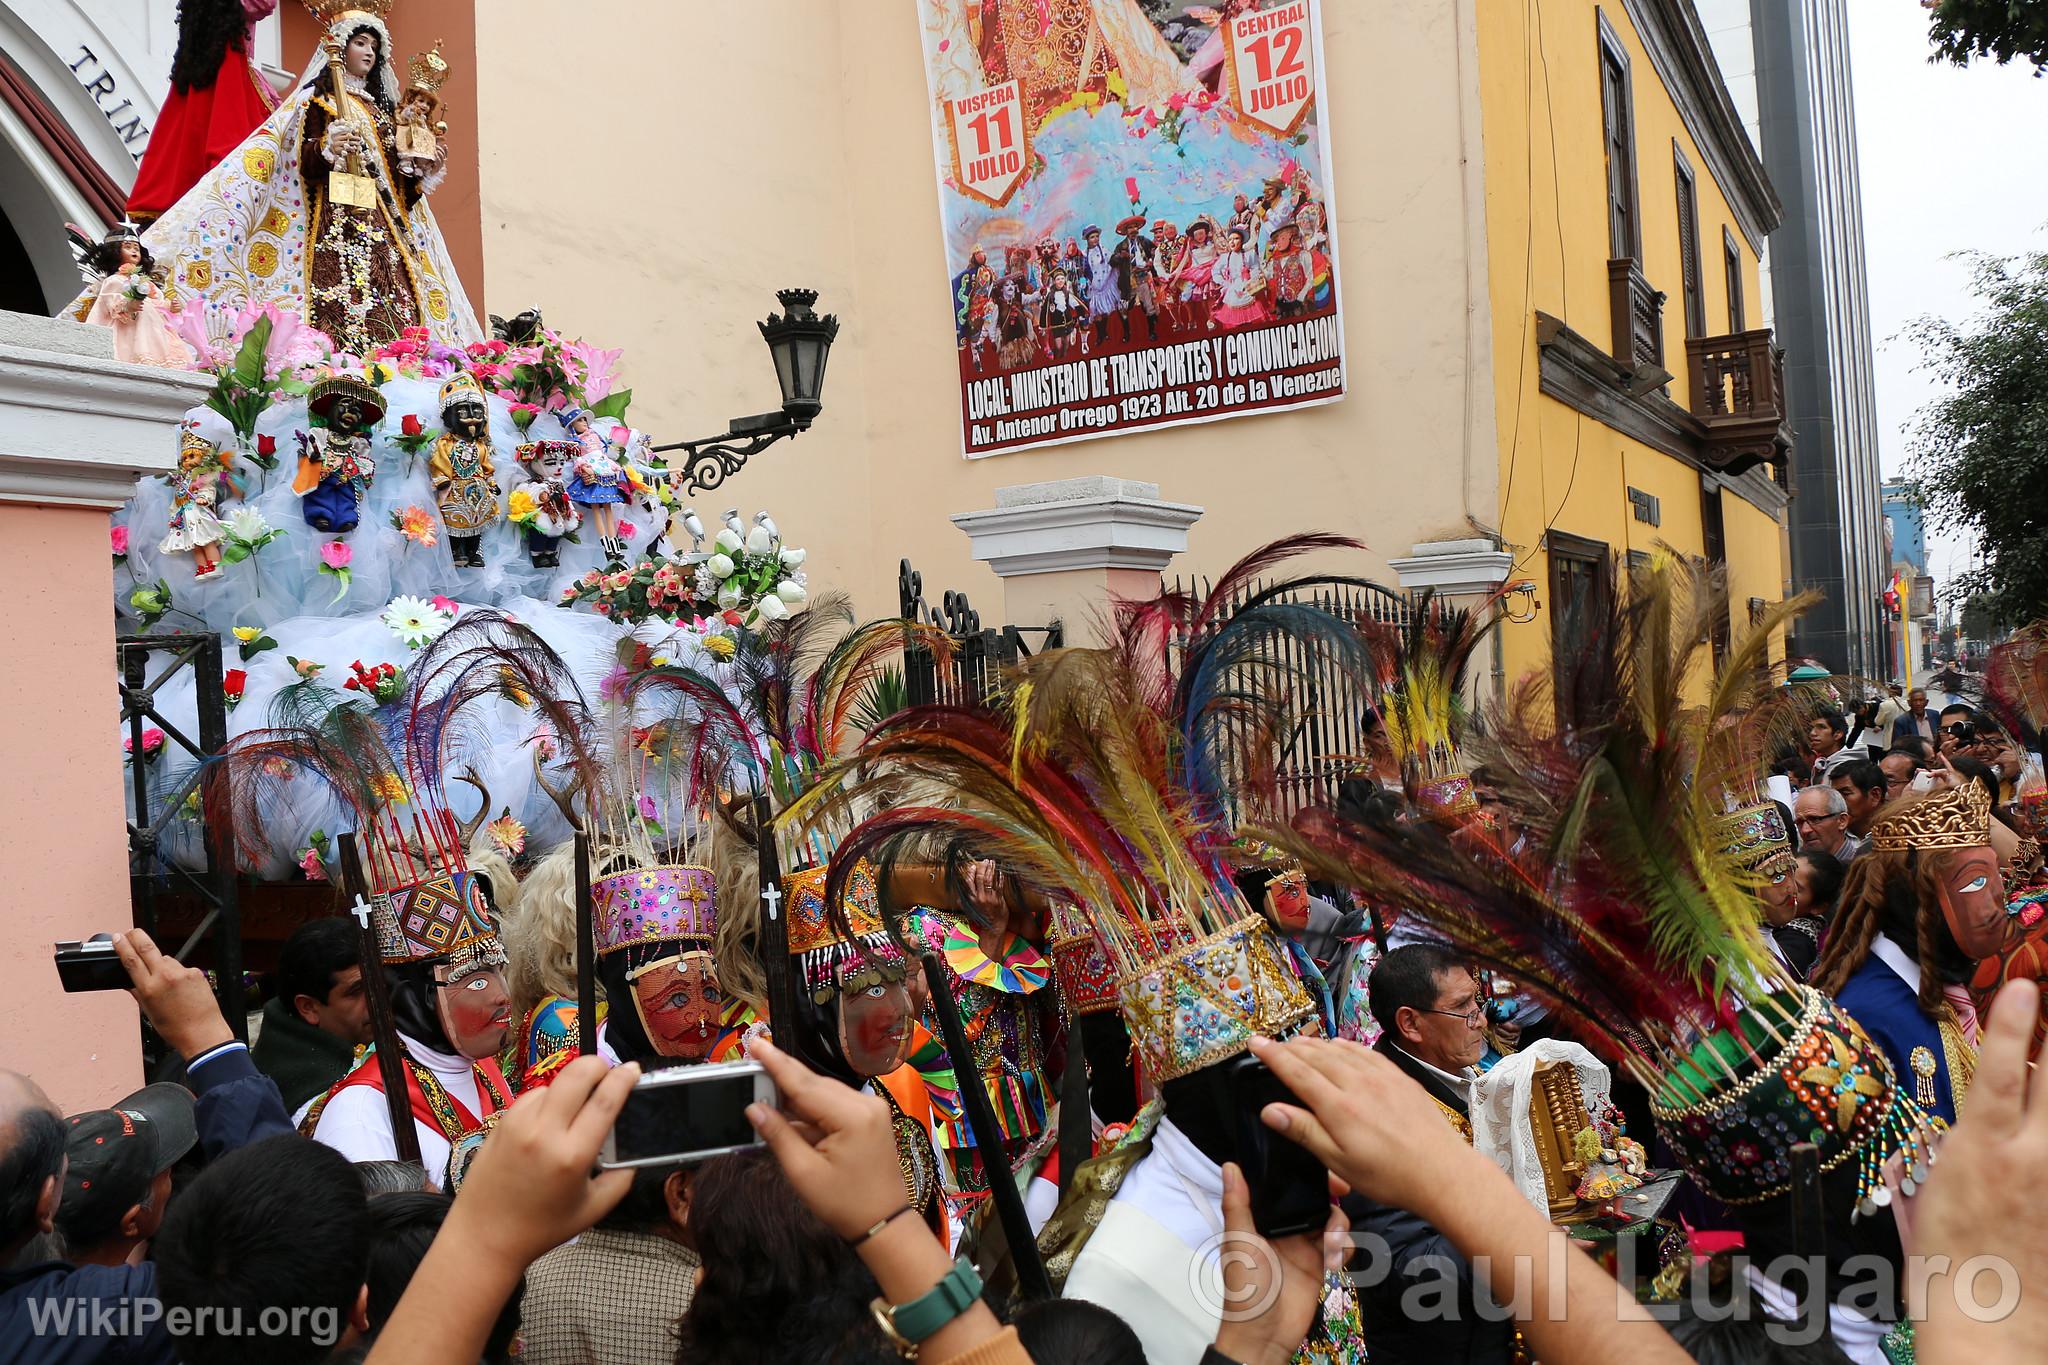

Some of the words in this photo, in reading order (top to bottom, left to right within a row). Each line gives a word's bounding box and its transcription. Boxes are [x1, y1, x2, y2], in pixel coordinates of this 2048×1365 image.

[1236, 2, 1305, 38] CENTRAL
[1244, 26, 1305, 83] 12
[957, 85, 1015, 116] VISPERA
[1250, 74, 1308, 113] JULIO
[967, 105, 1013, 156] 11
[968, 150, 1020, 184] JULIO
[967, 376, 1011, 420] LOCAL:
[1010, 360, 1088, 412] MINISTERIO
[1090, 355, 1110, 399] DE
[1110, 338, 1212, 396] TRANSPORTES
[1212, 336, 1223, 379] Y
[1225, 313, 1341, 378] COMUNICACION
[971, 424, 994, 446] Av.
[996, 413, 1057, 442] Antenor
[1060, 402, 1117, 431] Orrego
[1119, 394, 1162, 421] 1923
[1165, 390, 1193, 415] Alt.
[1196, 384, 1219, 410] 20
[1222, 381, 1246, 406] de
[1249, 378, 1268, 402] la
